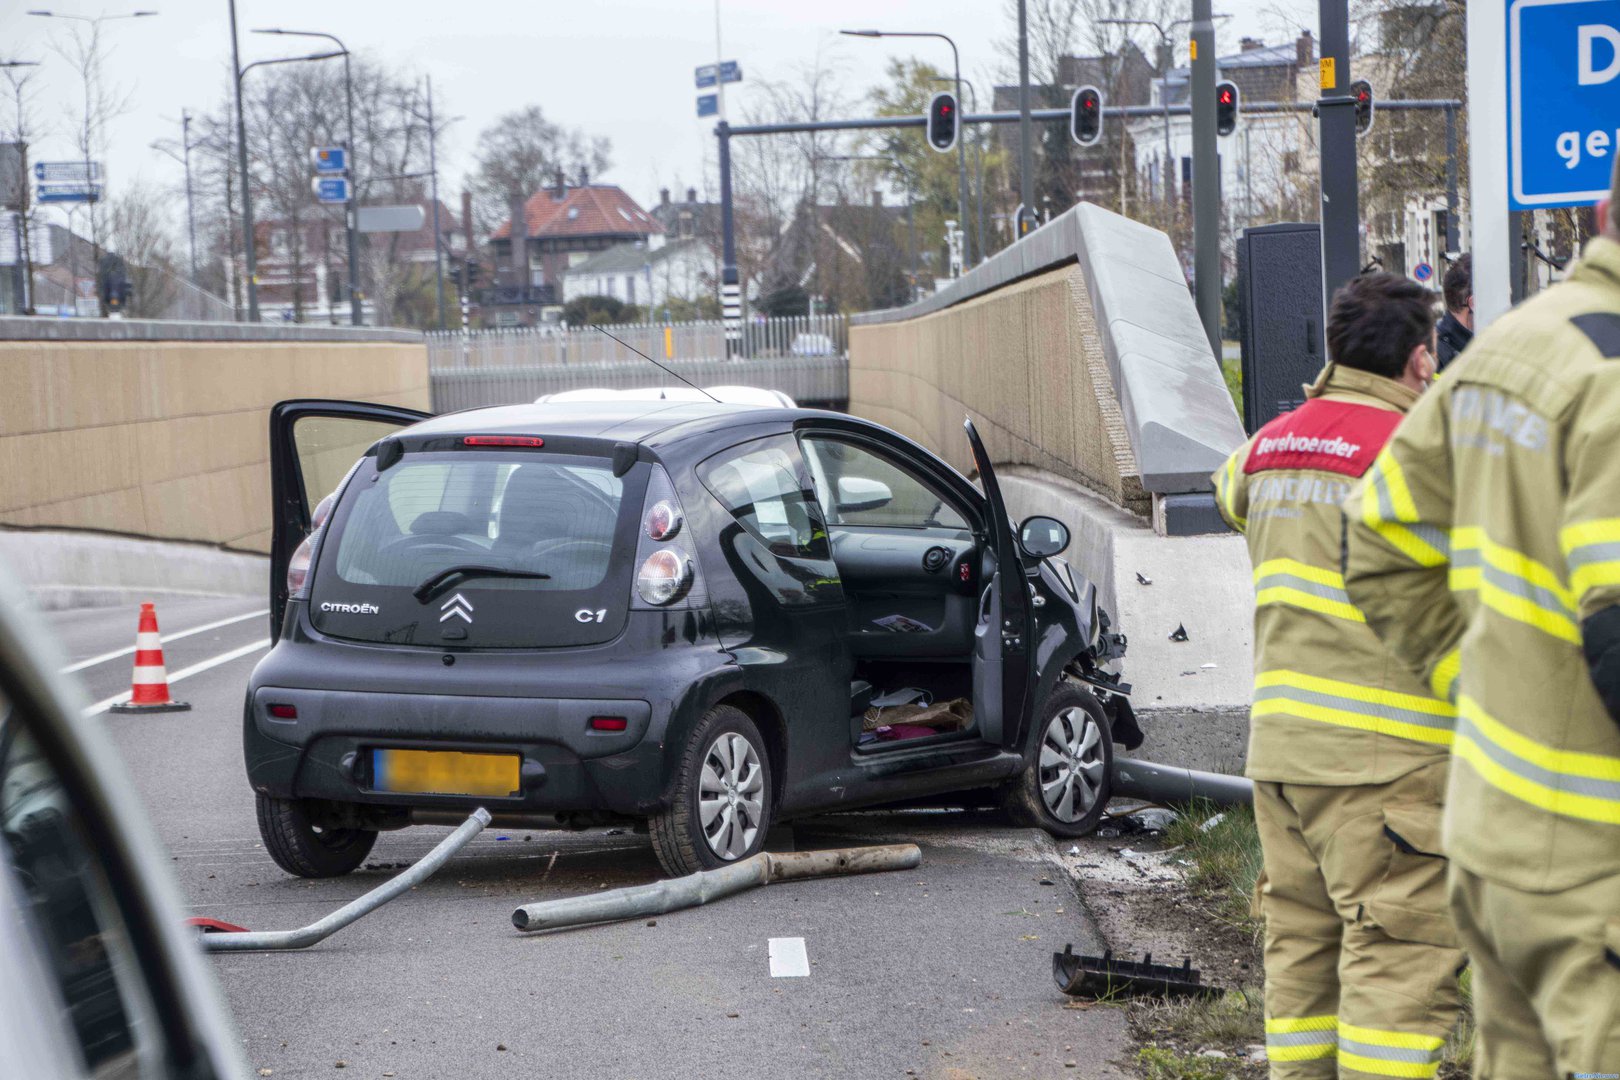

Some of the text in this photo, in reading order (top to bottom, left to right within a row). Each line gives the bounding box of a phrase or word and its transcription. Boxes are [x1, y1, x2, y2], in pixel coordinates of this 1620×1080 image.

[1556, 128, 1620, 170] ge
[321, 602, 379, 615] CITROËN
[574, 609, 607, 623] C1
